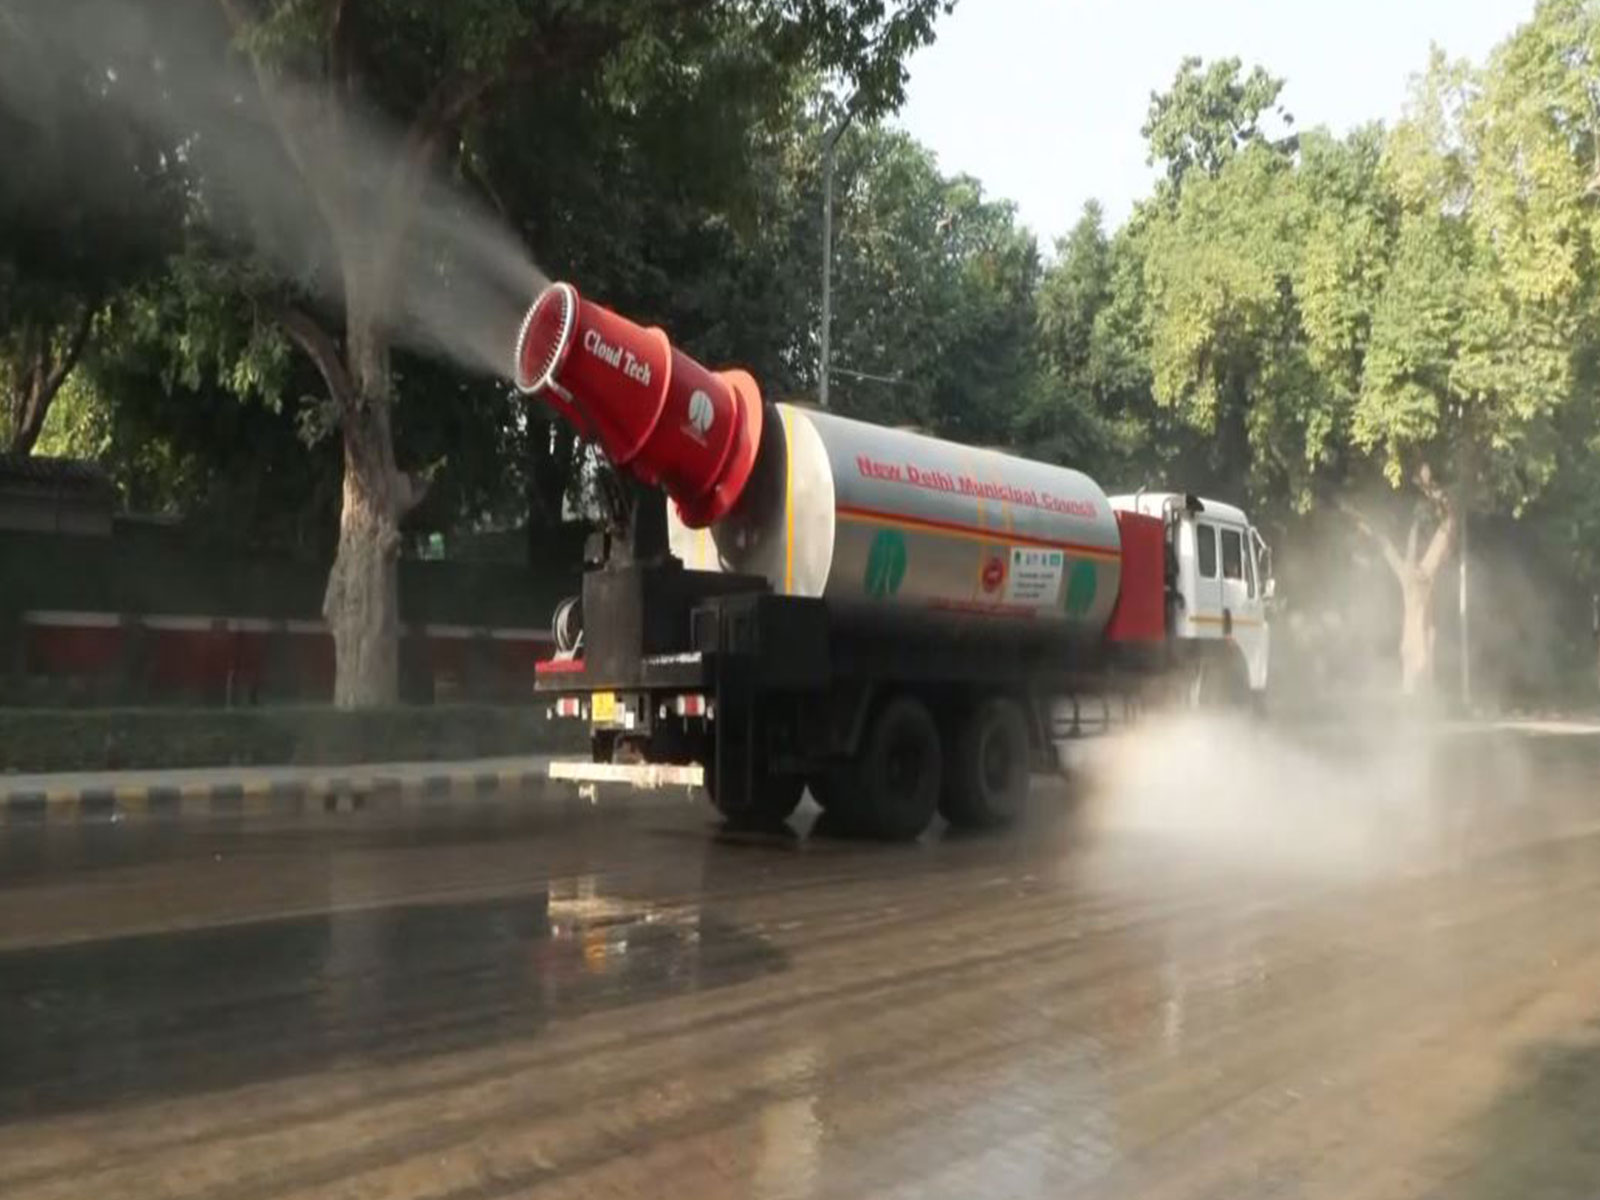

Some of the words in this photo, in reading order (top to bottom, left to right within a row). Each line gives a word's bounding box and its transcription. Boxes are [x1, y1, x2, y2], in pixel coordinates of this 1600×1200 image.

[583, 329, 623, 369] Cloud
[623, 351, 652, 387] Tech
[856, 455, 902, 481] New
[905, 463, 955, 492] Delhi
[957, 475, 1037, 507] Municipal
[1041, 493, 1097, 518] Council
